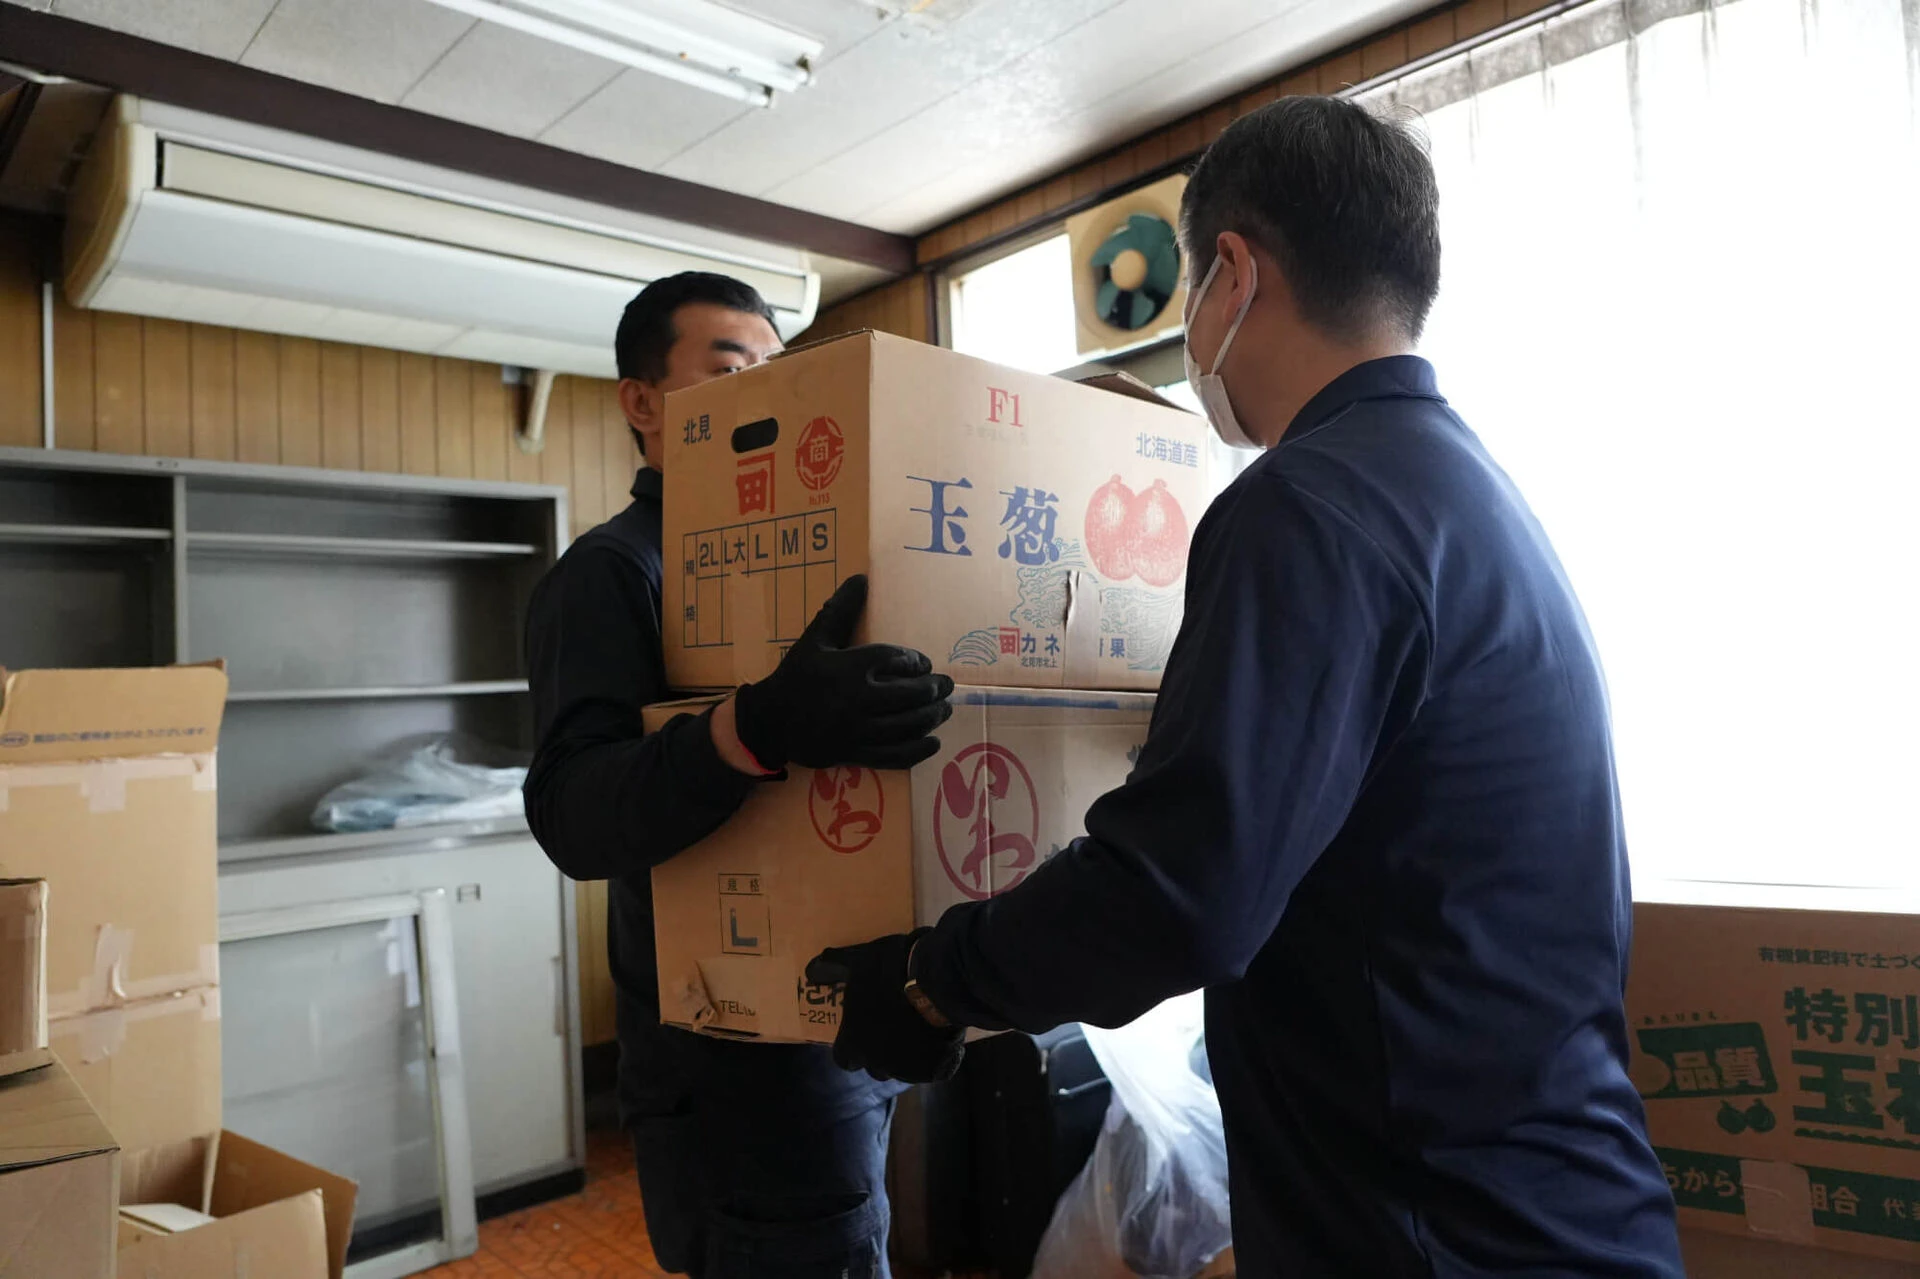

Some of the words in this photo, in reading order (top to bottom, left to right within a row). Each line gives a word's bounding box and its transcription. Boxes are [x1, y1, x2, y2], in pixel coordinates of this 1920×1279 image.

[985, 386, 1024, 428] F1
[683, 415, 711, 445] 北見
[1135, 431, 1198, 468] 北海道産
[903, 475, 1060, 566] 玉葱
[699, 541, 719, 568] 2L
[723, 536, 746, 564] L大
[755, 534, 769, 560] L
[782, 528, 799, 556] M
[812, 522, 828, 551] S
[730, 908, 758, 947] L
[1784, 986, 1920, 1050] 特別
[1672, 1046, 1766, 1092] 品質
